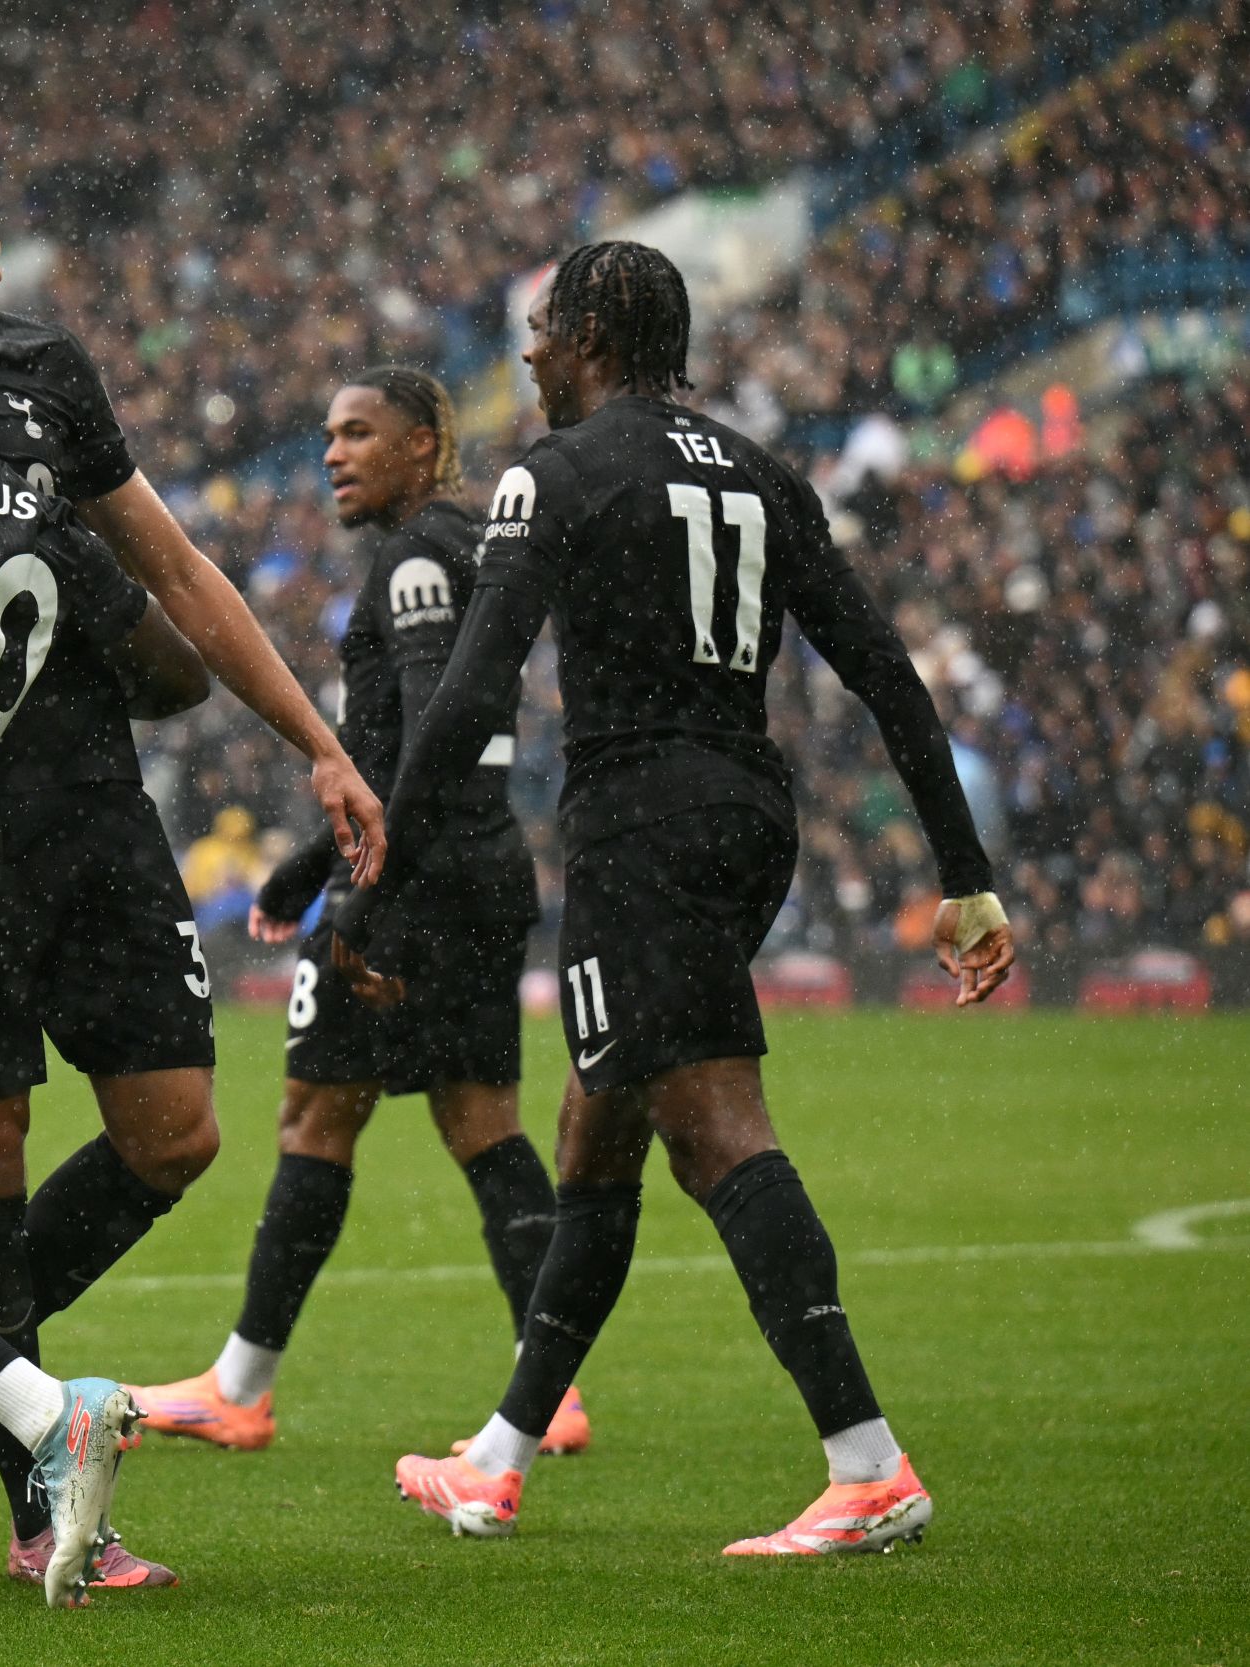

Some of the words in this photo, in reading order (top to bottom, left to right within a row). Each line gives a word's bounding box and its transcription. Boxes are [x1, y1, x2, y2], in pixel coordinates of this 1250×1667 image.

[665, 432, 734, 468] TEL
[666, 483, 767, 674] 11
[568, 956, 609, 1040] 11
